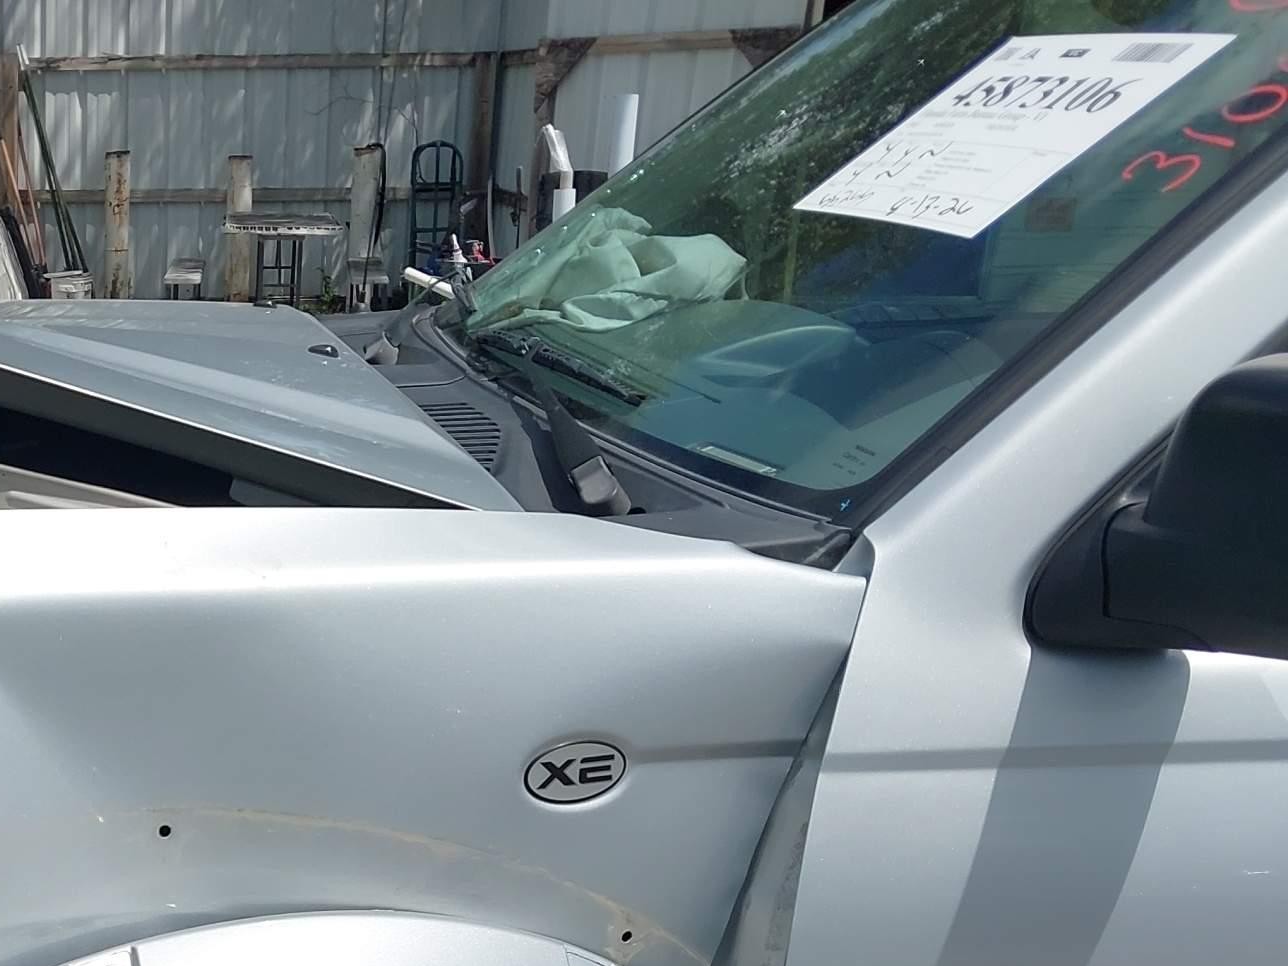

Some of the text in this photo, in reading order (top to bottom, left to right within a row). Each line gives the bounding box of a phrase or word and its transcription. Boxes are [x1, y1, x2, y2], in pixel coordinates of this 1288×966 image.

[952, 75, 1144, 113] 45873106
[1121, 58, 1288, 192] 310
[536, 753, 615, 790] XE
